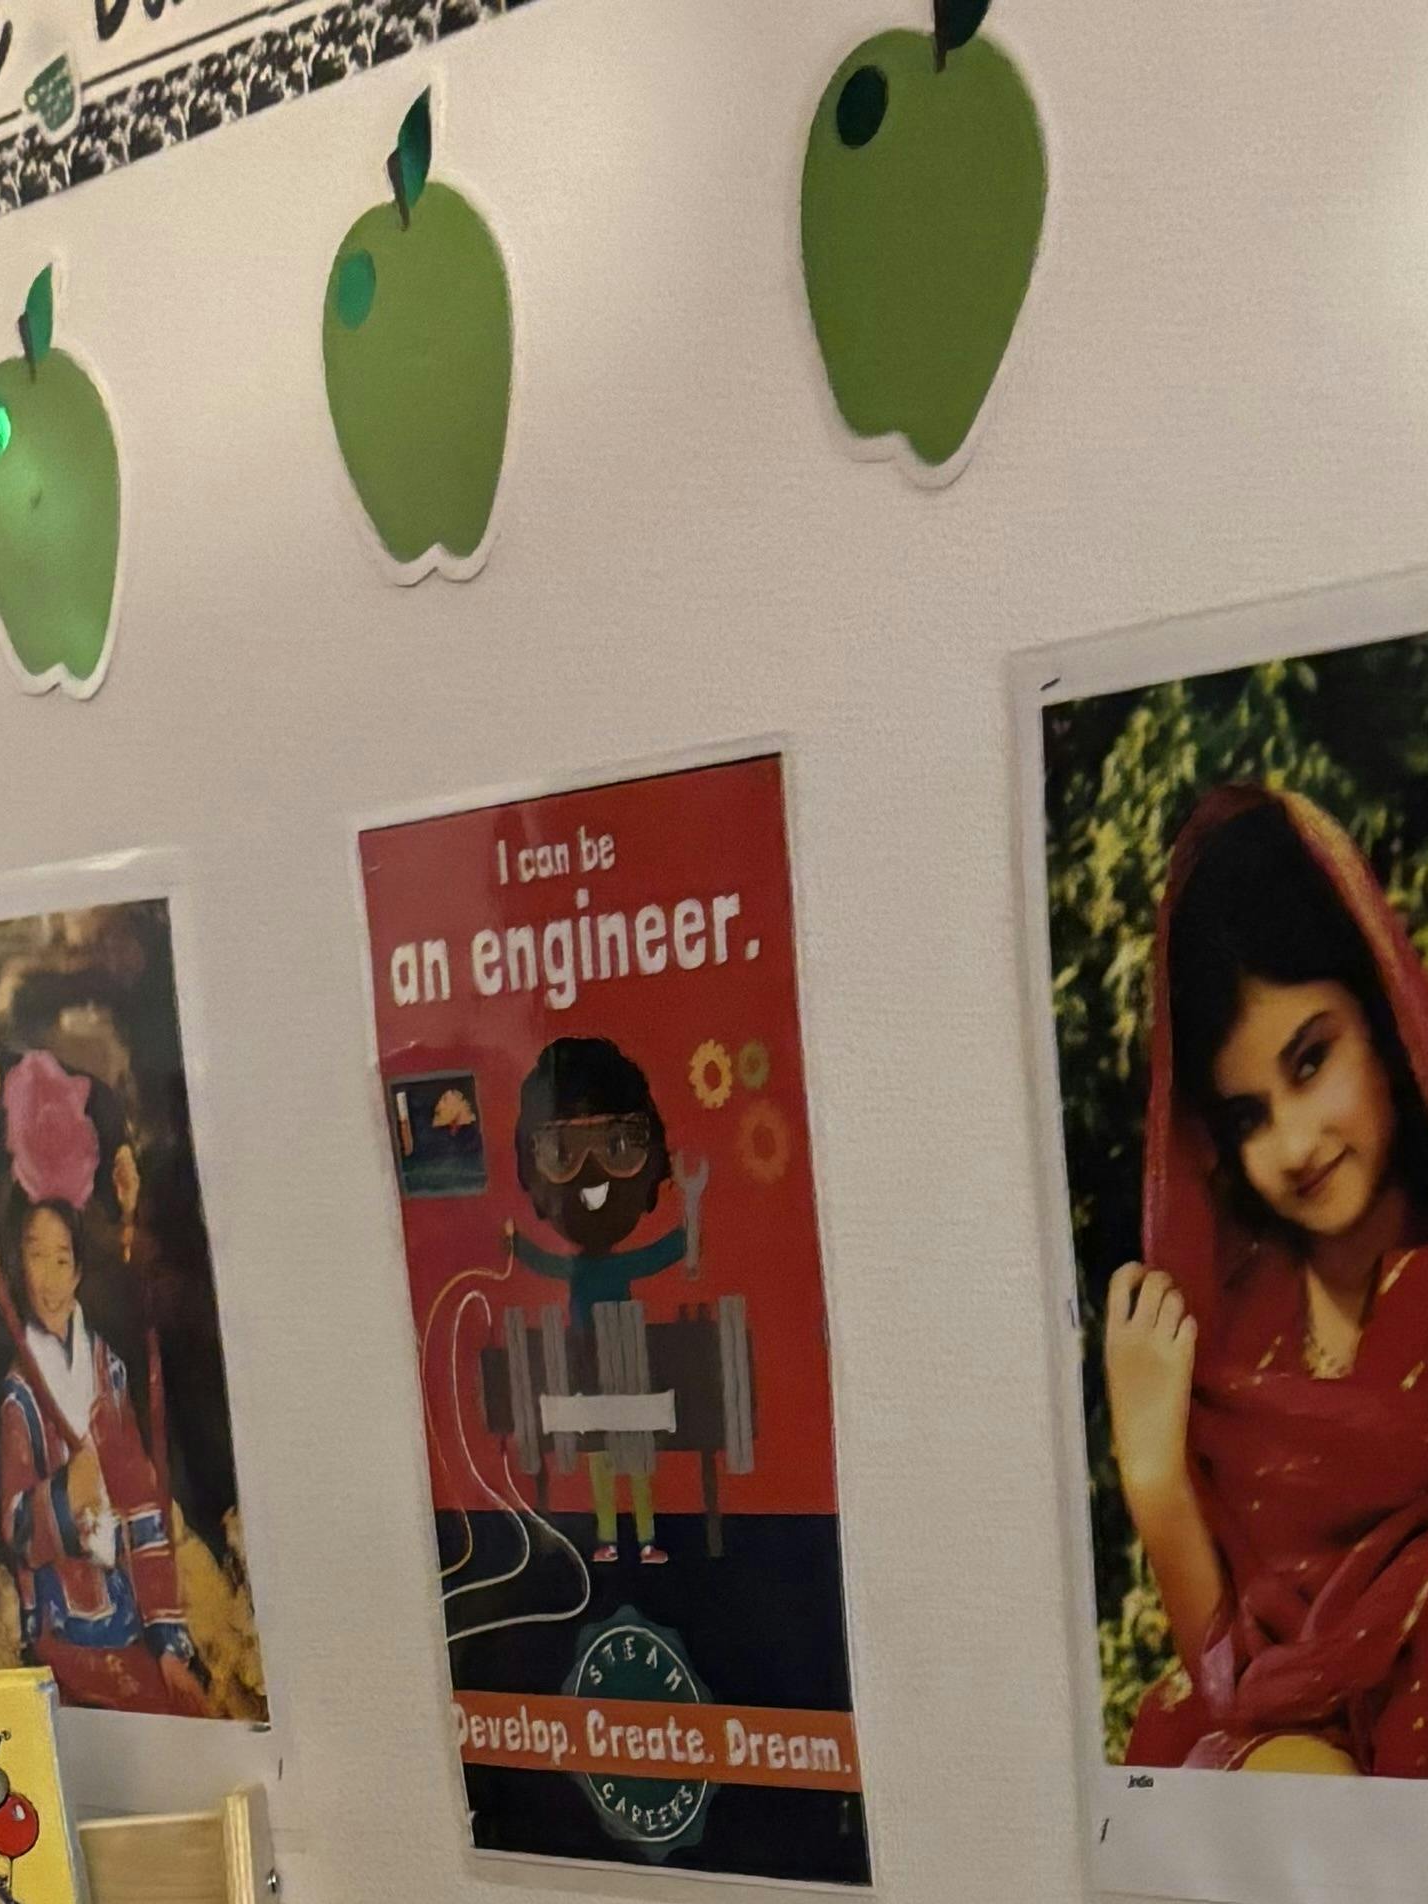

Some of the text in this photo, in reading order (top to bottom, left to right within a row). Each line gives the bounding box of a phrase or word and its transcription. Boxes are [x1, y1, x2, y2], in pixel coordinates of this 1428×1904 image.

[497, 826, 616, 885] I can be
[390, 887, 762, 1011] an engineer.
[588, 1635, 684, 1693] STEAM
[586, 1707, 715, 1766] Create.
[725, 1716, 853, 1775] Dream.
[601, 1781, 694, 1834] CAREERS
